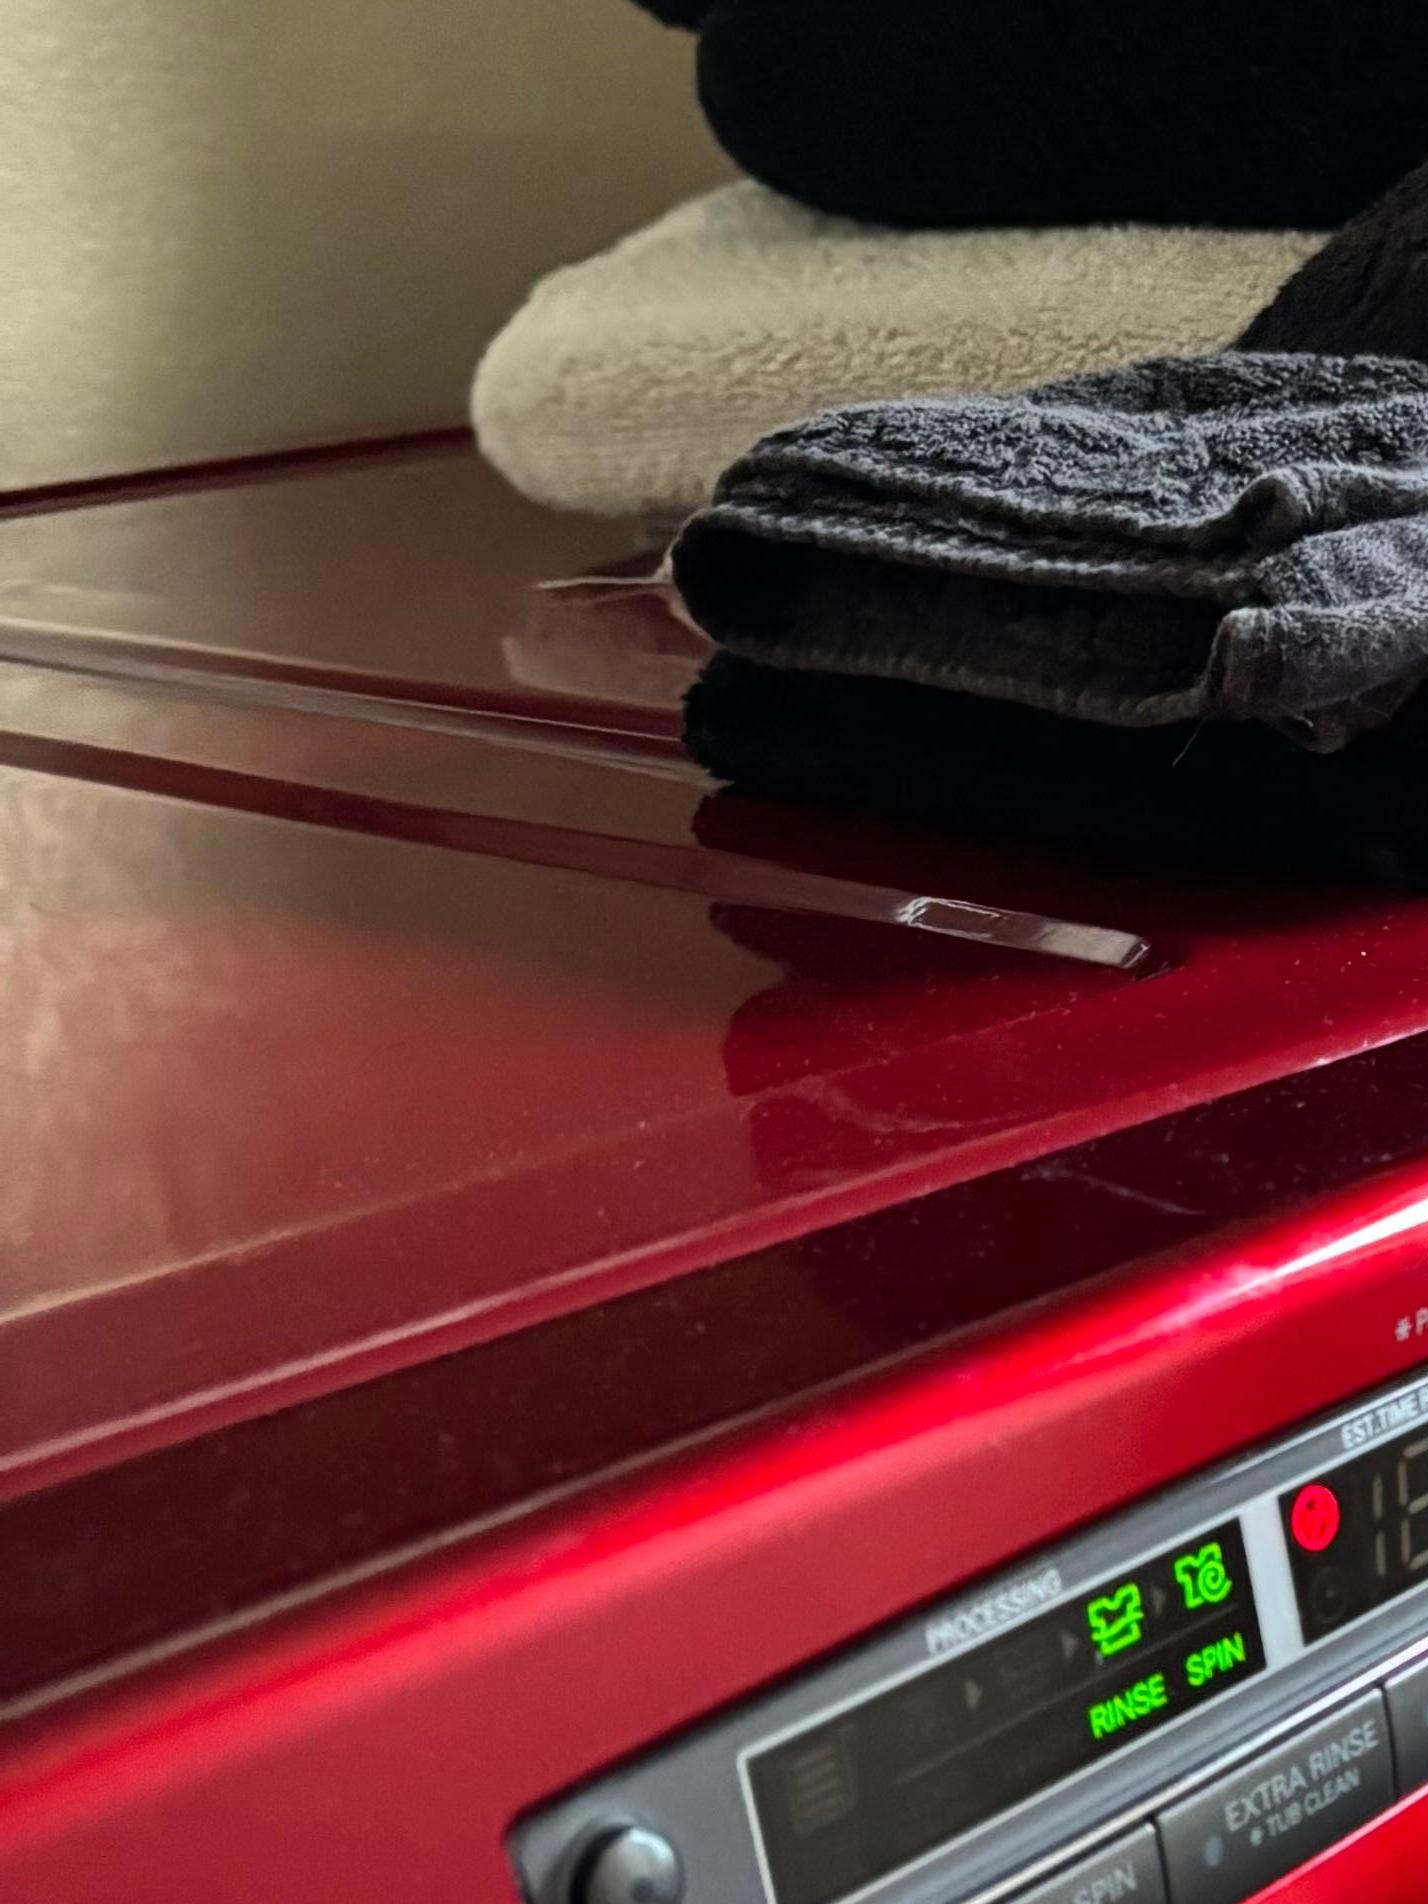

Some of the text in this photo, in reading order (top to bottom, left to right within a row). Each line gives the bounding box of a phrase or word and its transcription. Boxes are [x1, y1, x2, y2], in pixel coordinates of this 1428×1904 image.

[925, 1566, 1063, 1656] PROCESSING
[1185, 1632, 1246, 1687] SPIN
[1088, 1672, 1168, 1740] RINSE
[1224, 1719, 1380, 1833] EXTRA RINSE
[1267, 1769, 1362, 1842] TUB CLEAN
